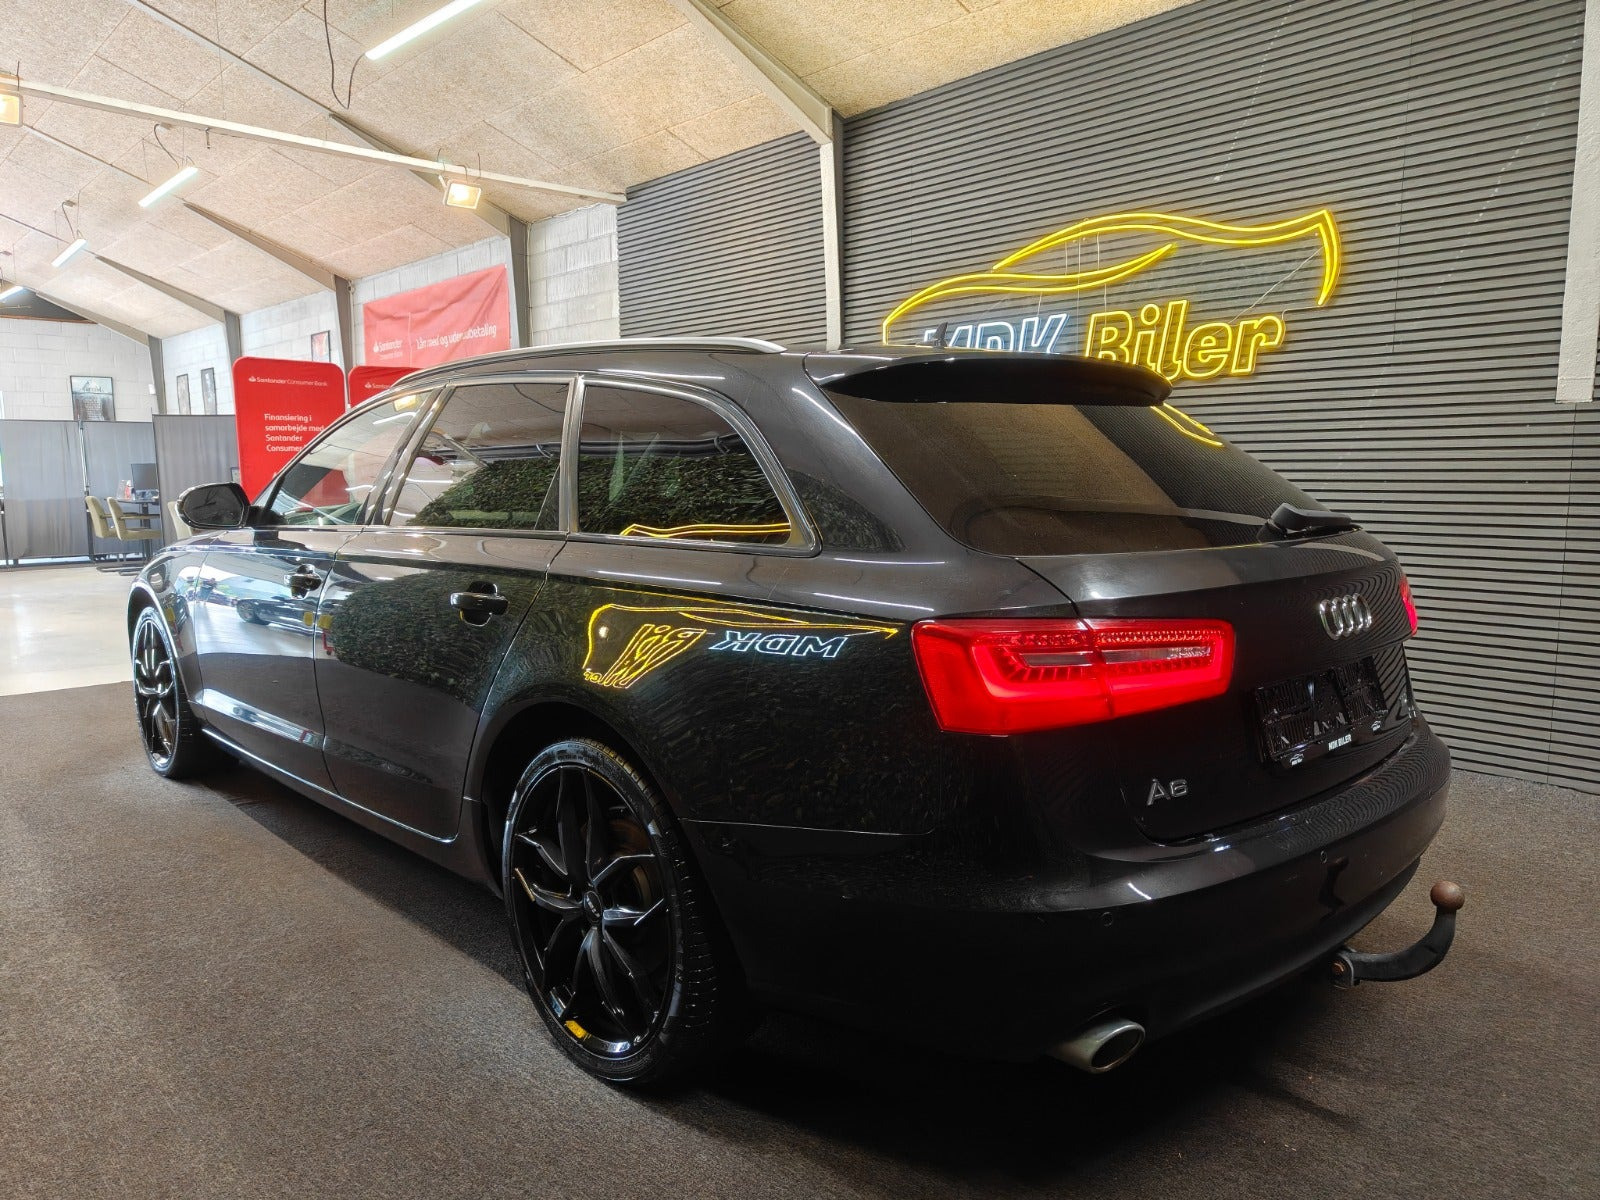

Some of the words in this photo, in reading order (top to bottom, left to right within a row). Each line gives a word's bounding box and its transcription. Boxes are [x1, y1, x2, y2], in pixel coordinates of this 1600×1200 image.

[1085, 299, 1285, 381] Biler
[257, 376, 286, 384] Santander
[264, 413, 308, 423] Finansiering
[265, 424, 308, 433] samarbejde
[308, 424, 324, 432] med
[1147, 778, 1188, 806] A6
